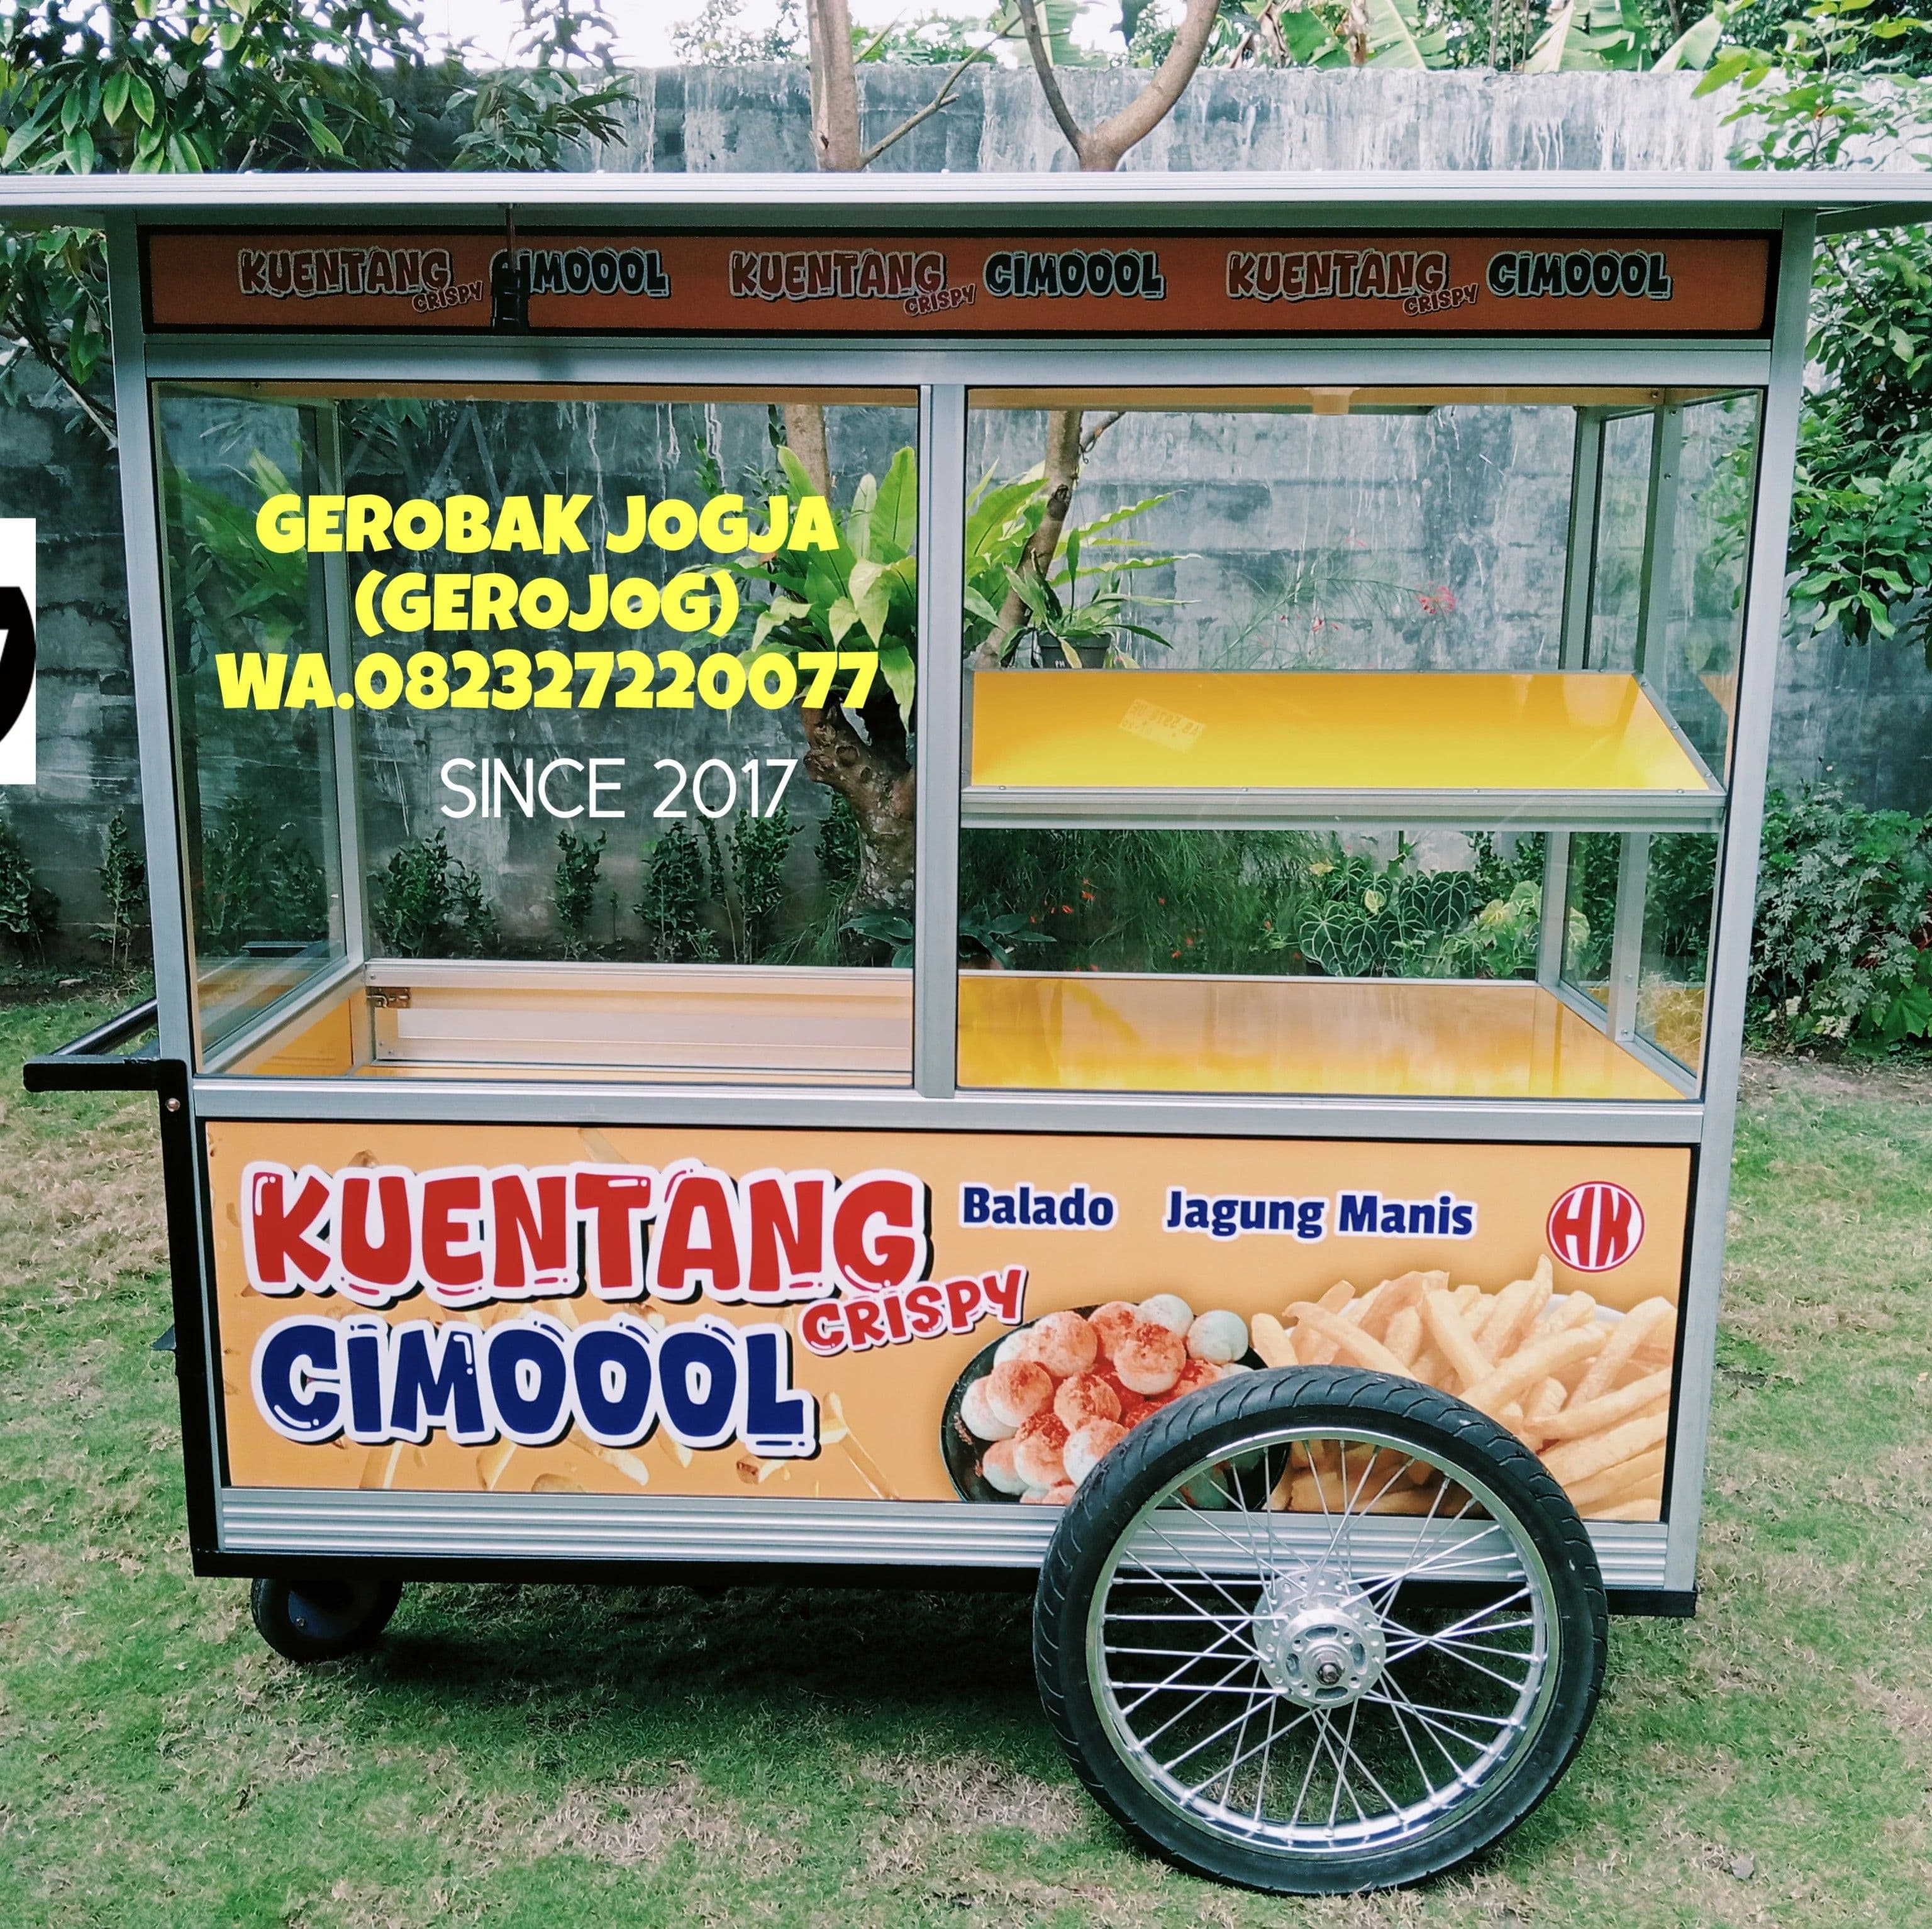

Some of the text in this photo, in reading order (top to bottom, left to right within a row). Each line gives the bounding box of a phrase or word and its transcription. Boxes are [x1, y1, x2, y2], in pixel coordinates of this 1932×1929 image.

[240, 248, 450, 298] KUENTANG
[413, 281, 483, 312] CRISPY
[730, 249, 1165, 299] KUENTANG CIMOOOL
[1226, 248, 1672, 299] KUENTANG CIMOOOL
[904, 284, 975, 316] CRISPY
[1403, 284, 1477, 316] CRISPY
[963, 1187, 1114, 1225] Balado
[1167, 1191, 1473, 1239] Jagung Manis
[252, 1170, 916, 1293] KUENTANG
[802, 1269, 1022, 1351] CRISPY
[260, 1322, 807, 1447] CIMOOOL
